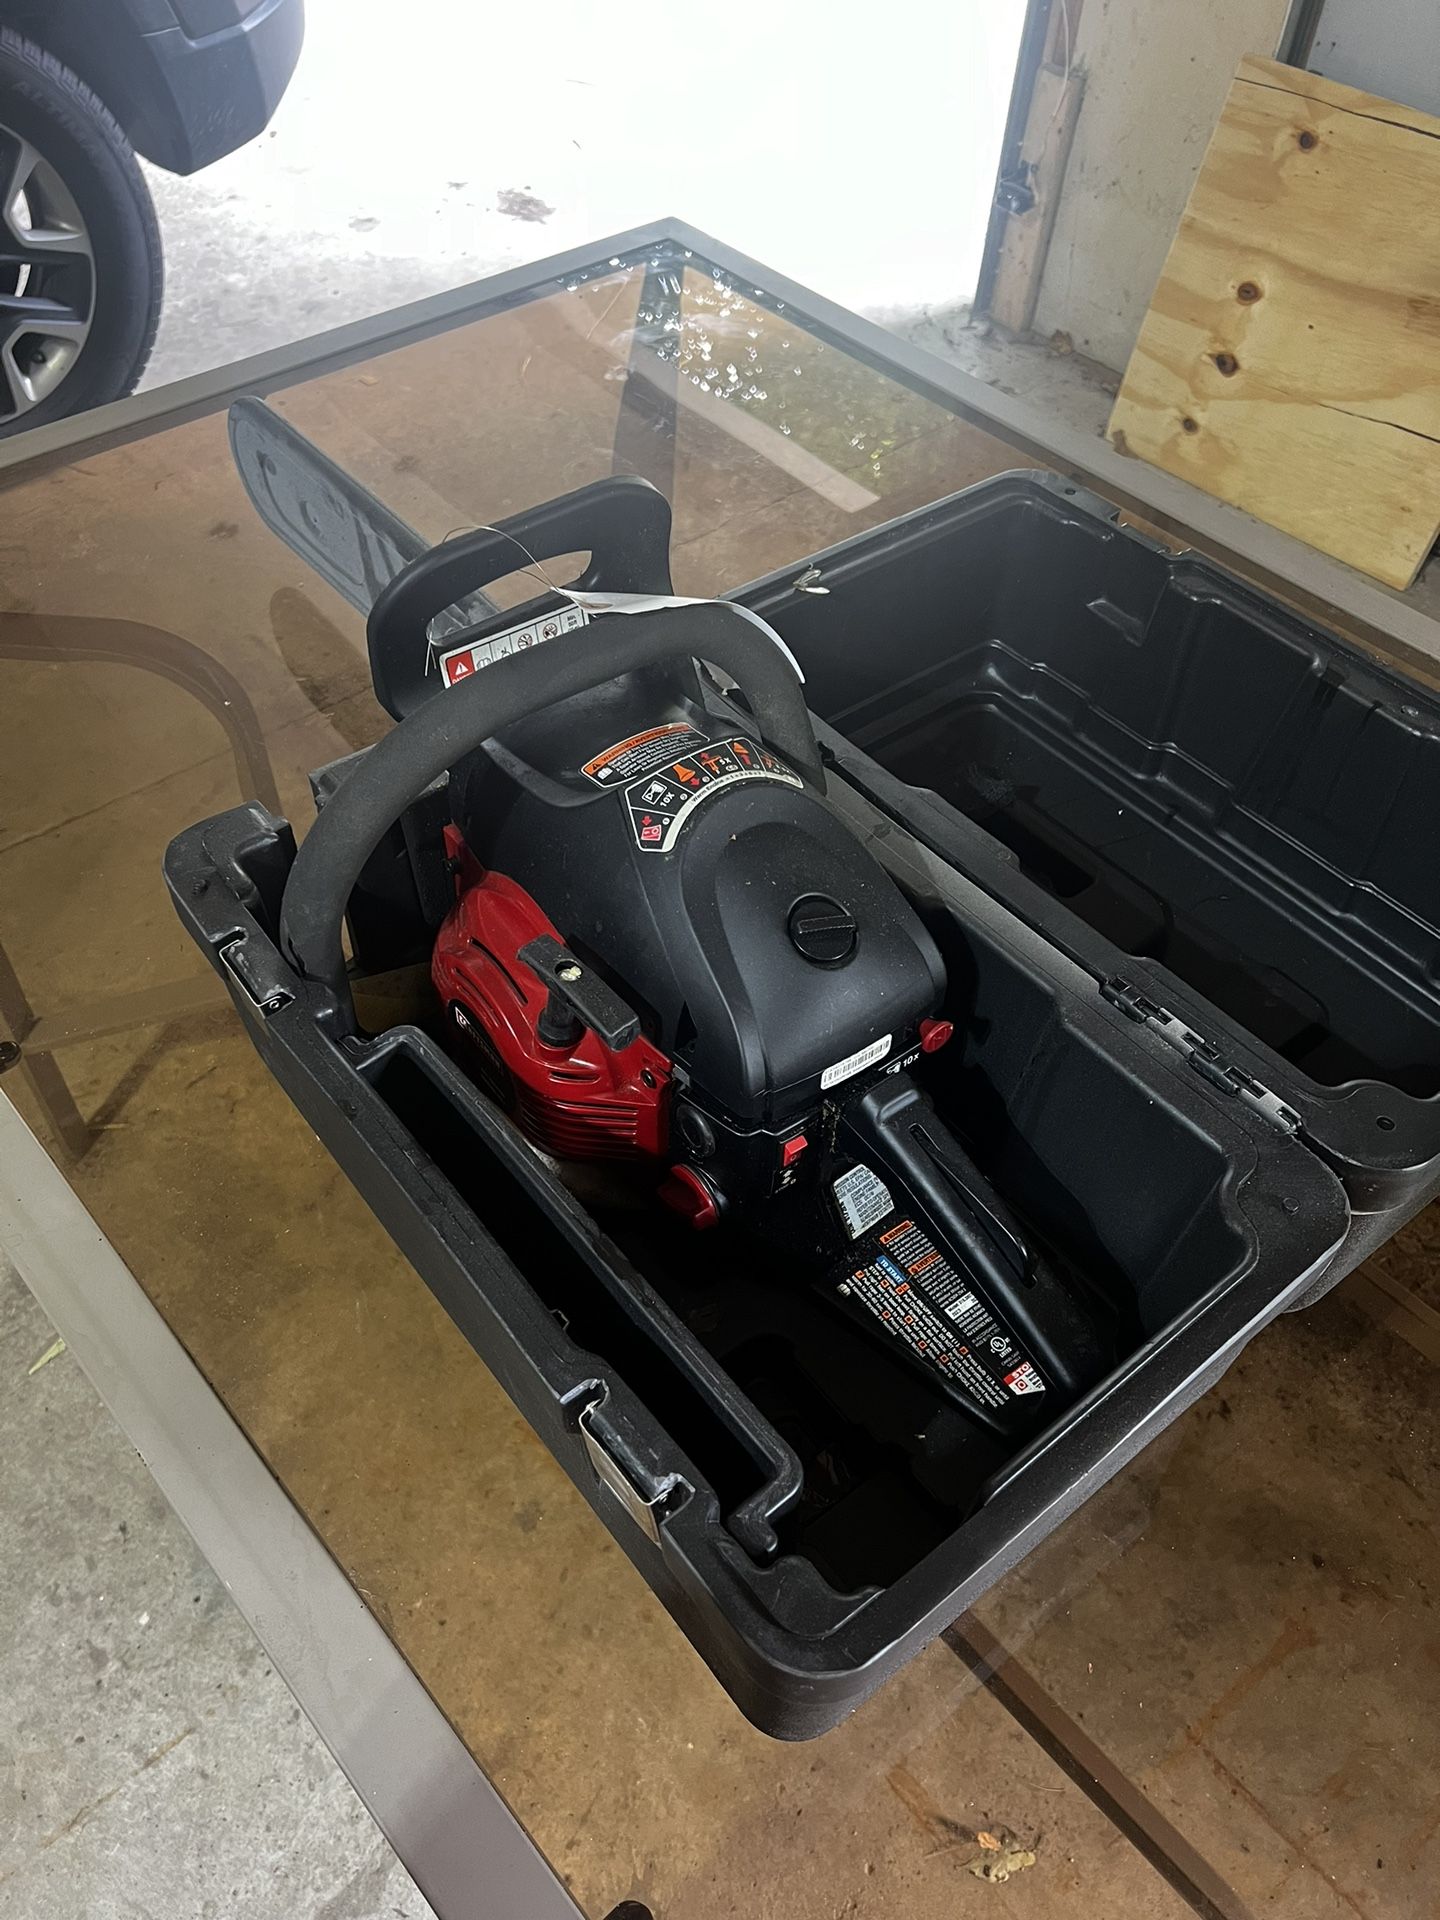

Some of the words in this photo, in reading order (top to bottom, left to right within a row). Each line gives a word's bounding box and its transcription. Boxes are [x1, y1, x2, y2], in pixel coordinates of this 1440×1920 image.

[719, 757, 732, 766] 5X
[660, 792, 675, 807] 10X
[879, 1258, 889, 1268] TO
[885, 1265, 903, 1284] START
